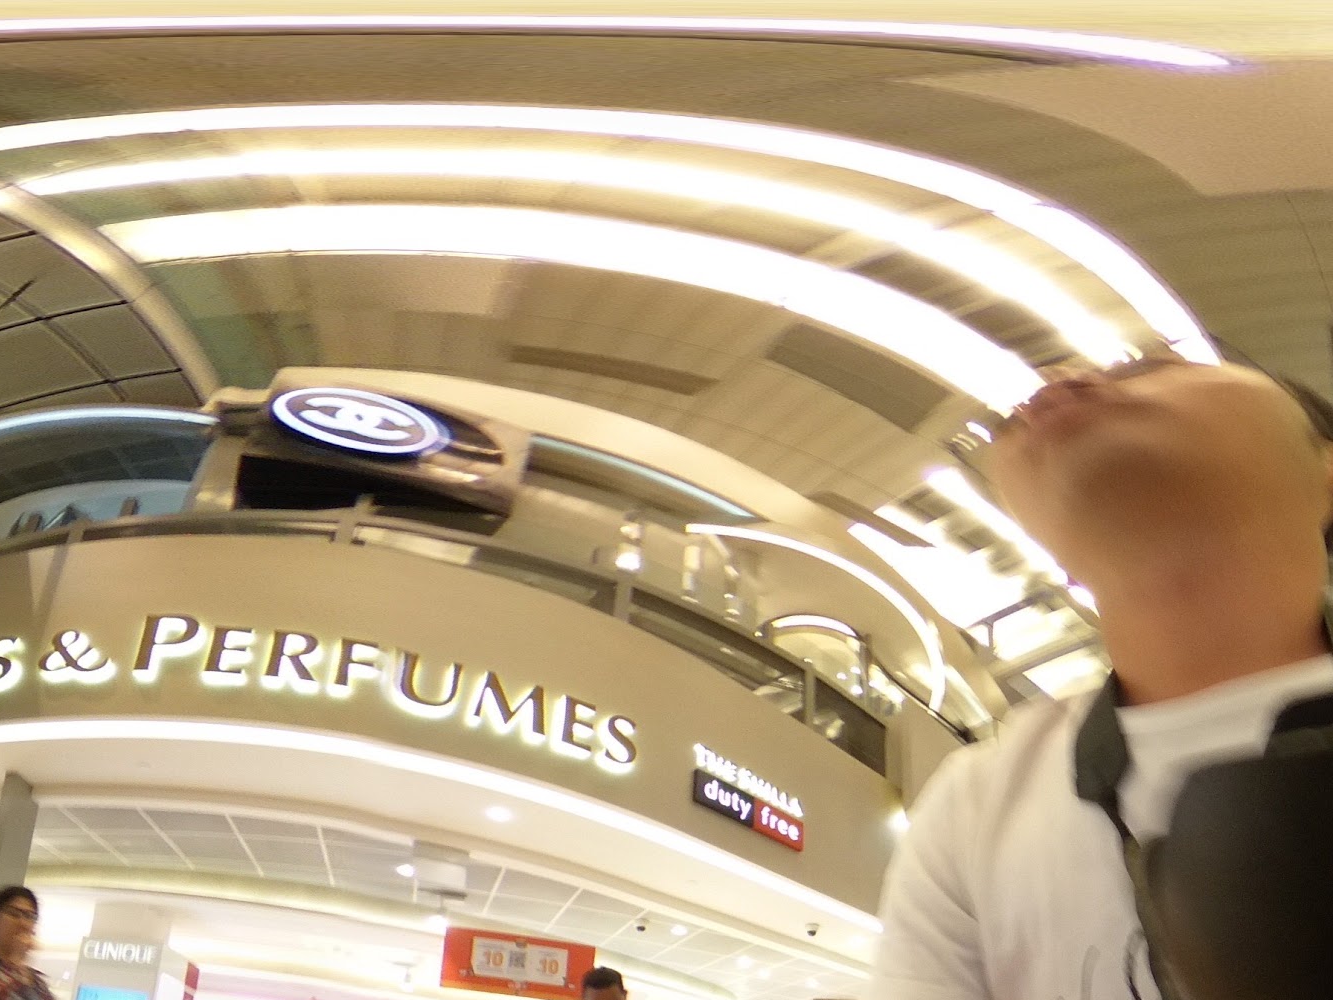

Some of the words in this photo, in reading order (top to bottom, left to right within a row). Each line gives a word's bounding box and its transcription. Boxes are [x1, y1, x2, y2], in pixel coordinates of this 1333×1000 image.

[38, 629, 117, 684] &
[132, 613, 640, 775] PERFUMES
[703, 780, 752, 820] duty
[761, 806, 800, 841] free
